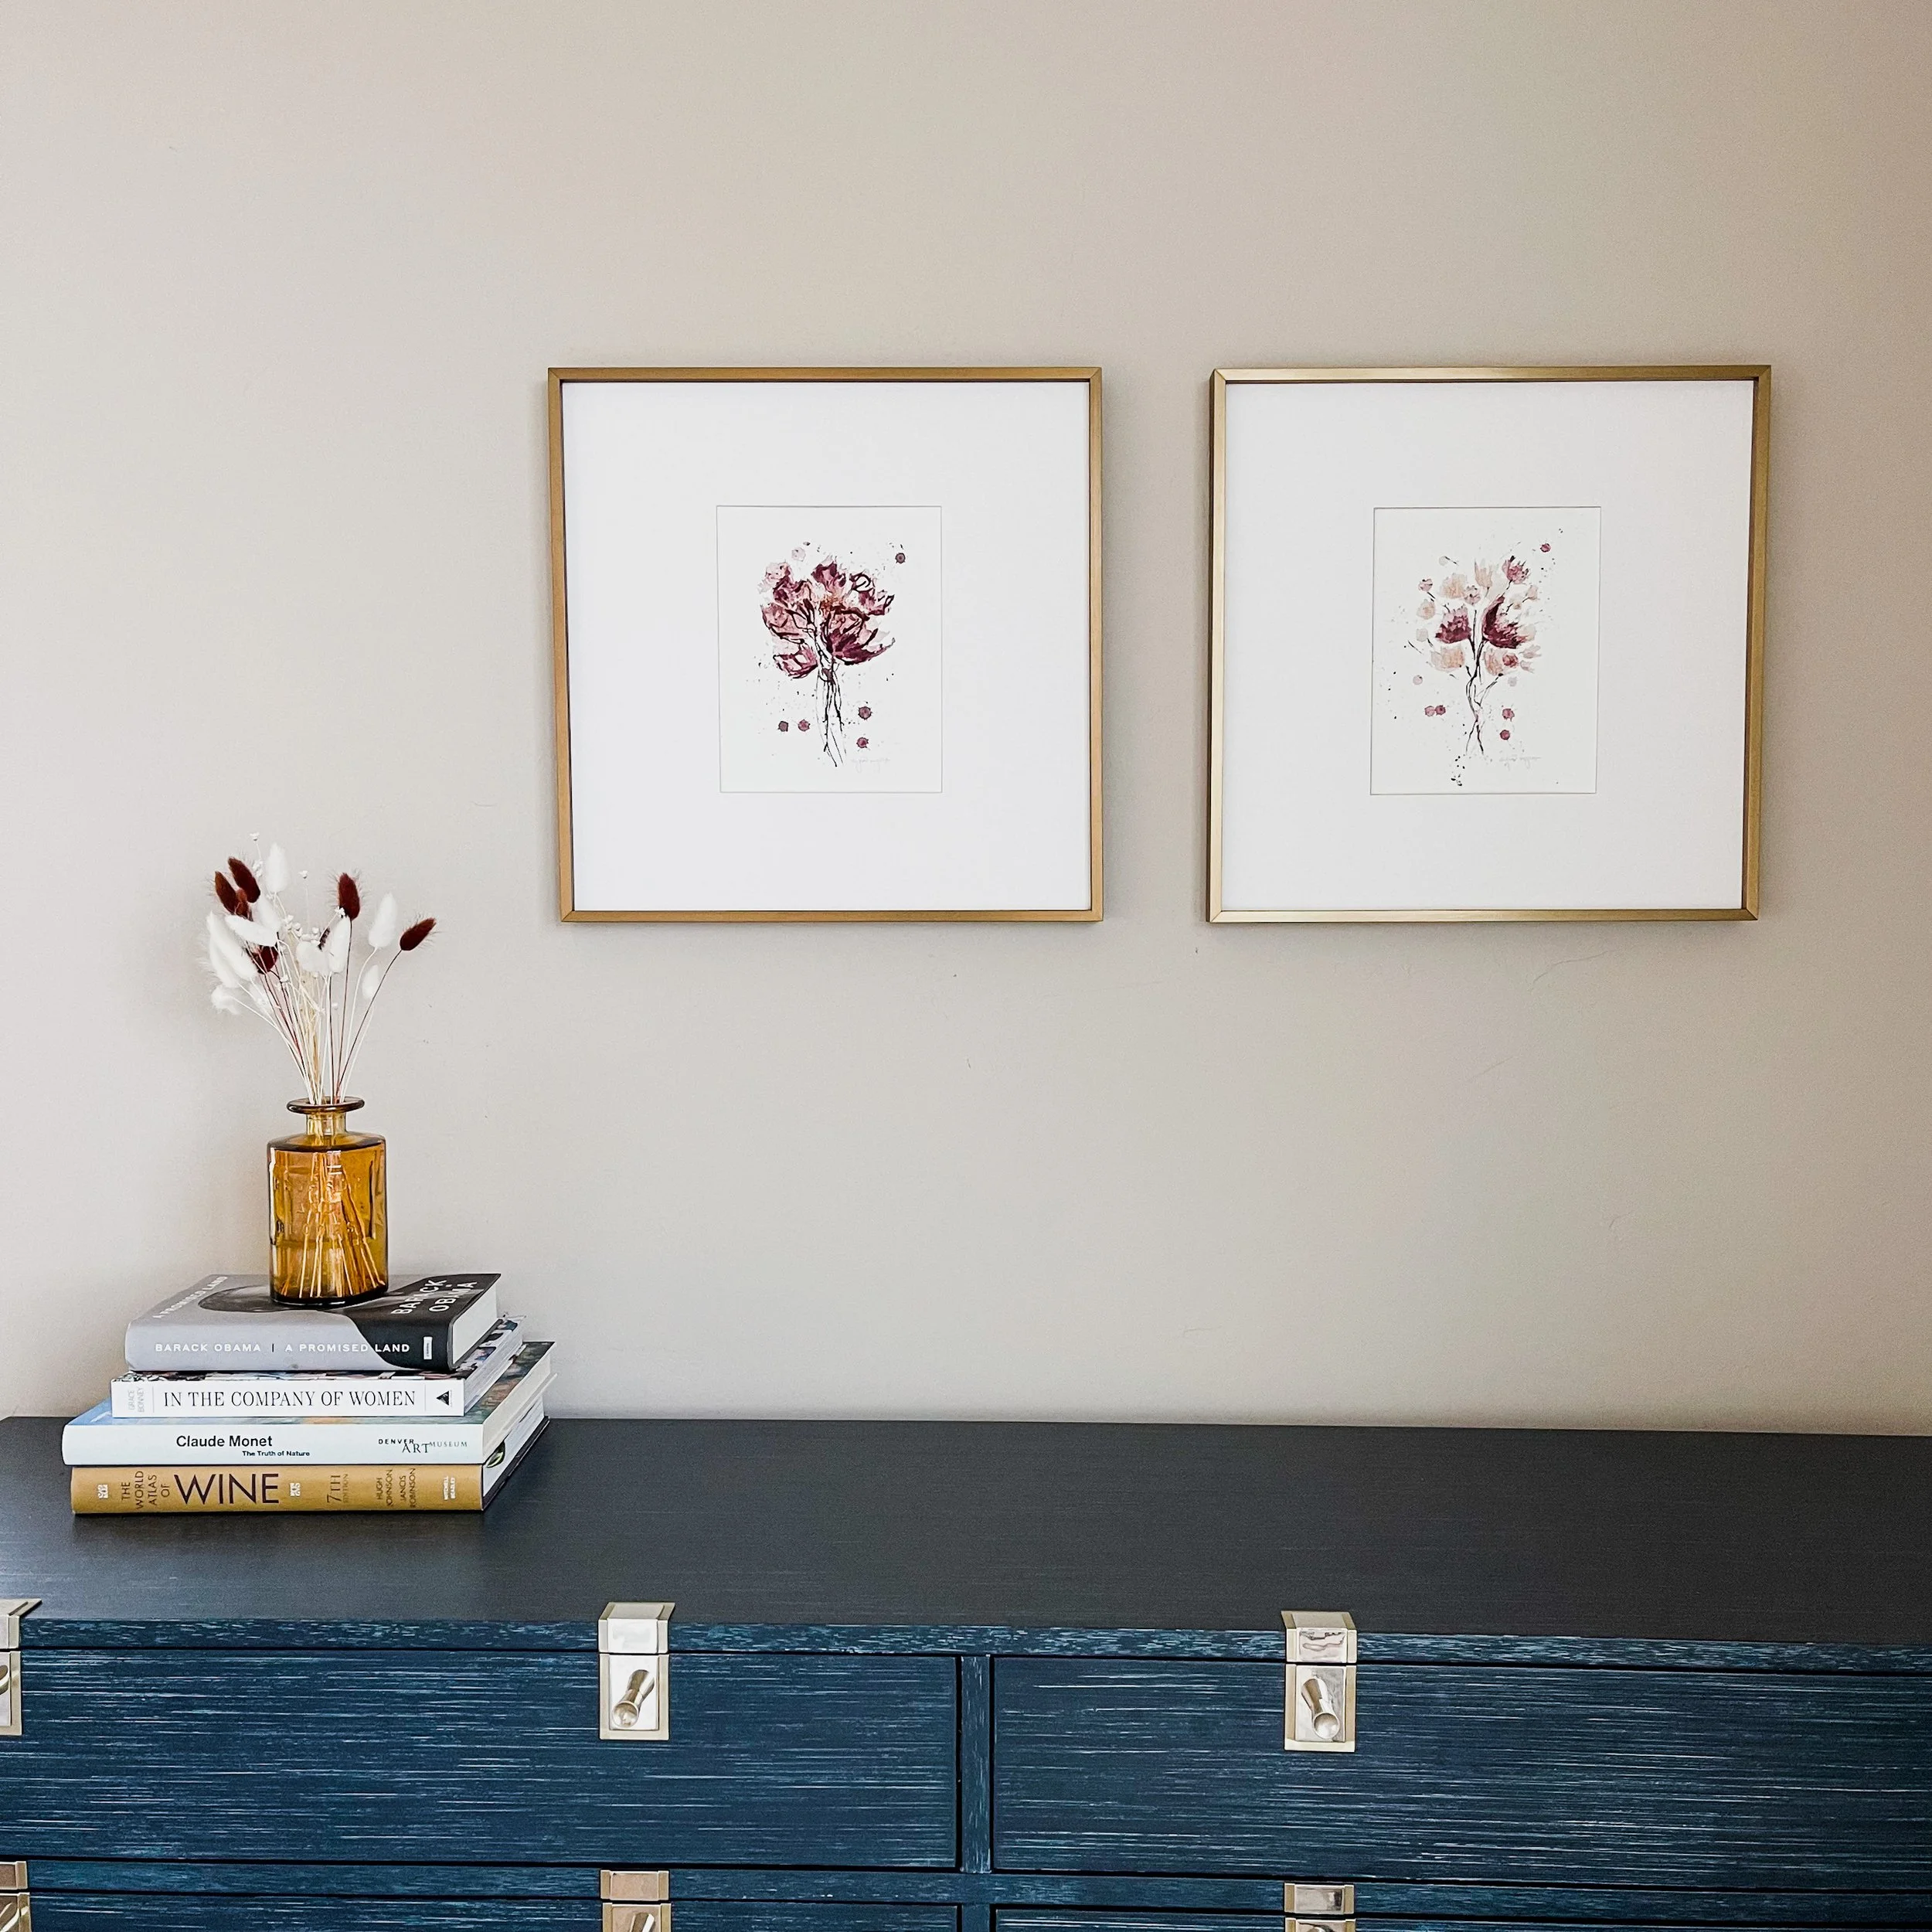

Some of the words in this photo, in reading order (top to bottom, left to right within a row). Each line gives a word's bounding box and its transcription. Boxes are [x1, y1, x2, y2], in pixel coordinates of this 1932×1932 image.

[390, 1280, 447, 1314] BARACK
[429, 1282, 478, 1311] OBAMA
[155, 1343, 208, 1352] BARACK
[214, 1343, 261, 1352] OBAMA
[284, 1344, 293, 1352] A
[299, 1344, 369, 1352] PROMISED
[375, 1344, 410, 1352] LAND
[164, 1392, 182, 1406] IN
[188, 1392, 225, 1406] THE
[231, 1391, 315, 1406] COMPANY
[321, 1391, 343, 1406] OF
[349, 1390, 416, 1406] WOMEN
[176, 1435, 225, 1447] Claude
[229, 1435, 273, 1447] Monet
[402, 1443, 430, 1453] ART
[121, 1482, 131, 1500] THE
[134, 1471, 144, 1509] WORLD
[148, 1475, 158, 1505] ATLAS
[161, 1484, 170, 1498] OF
[174, 1474, 279, 1505] WINE
[327, 1475, 342, 1503] 7TH
